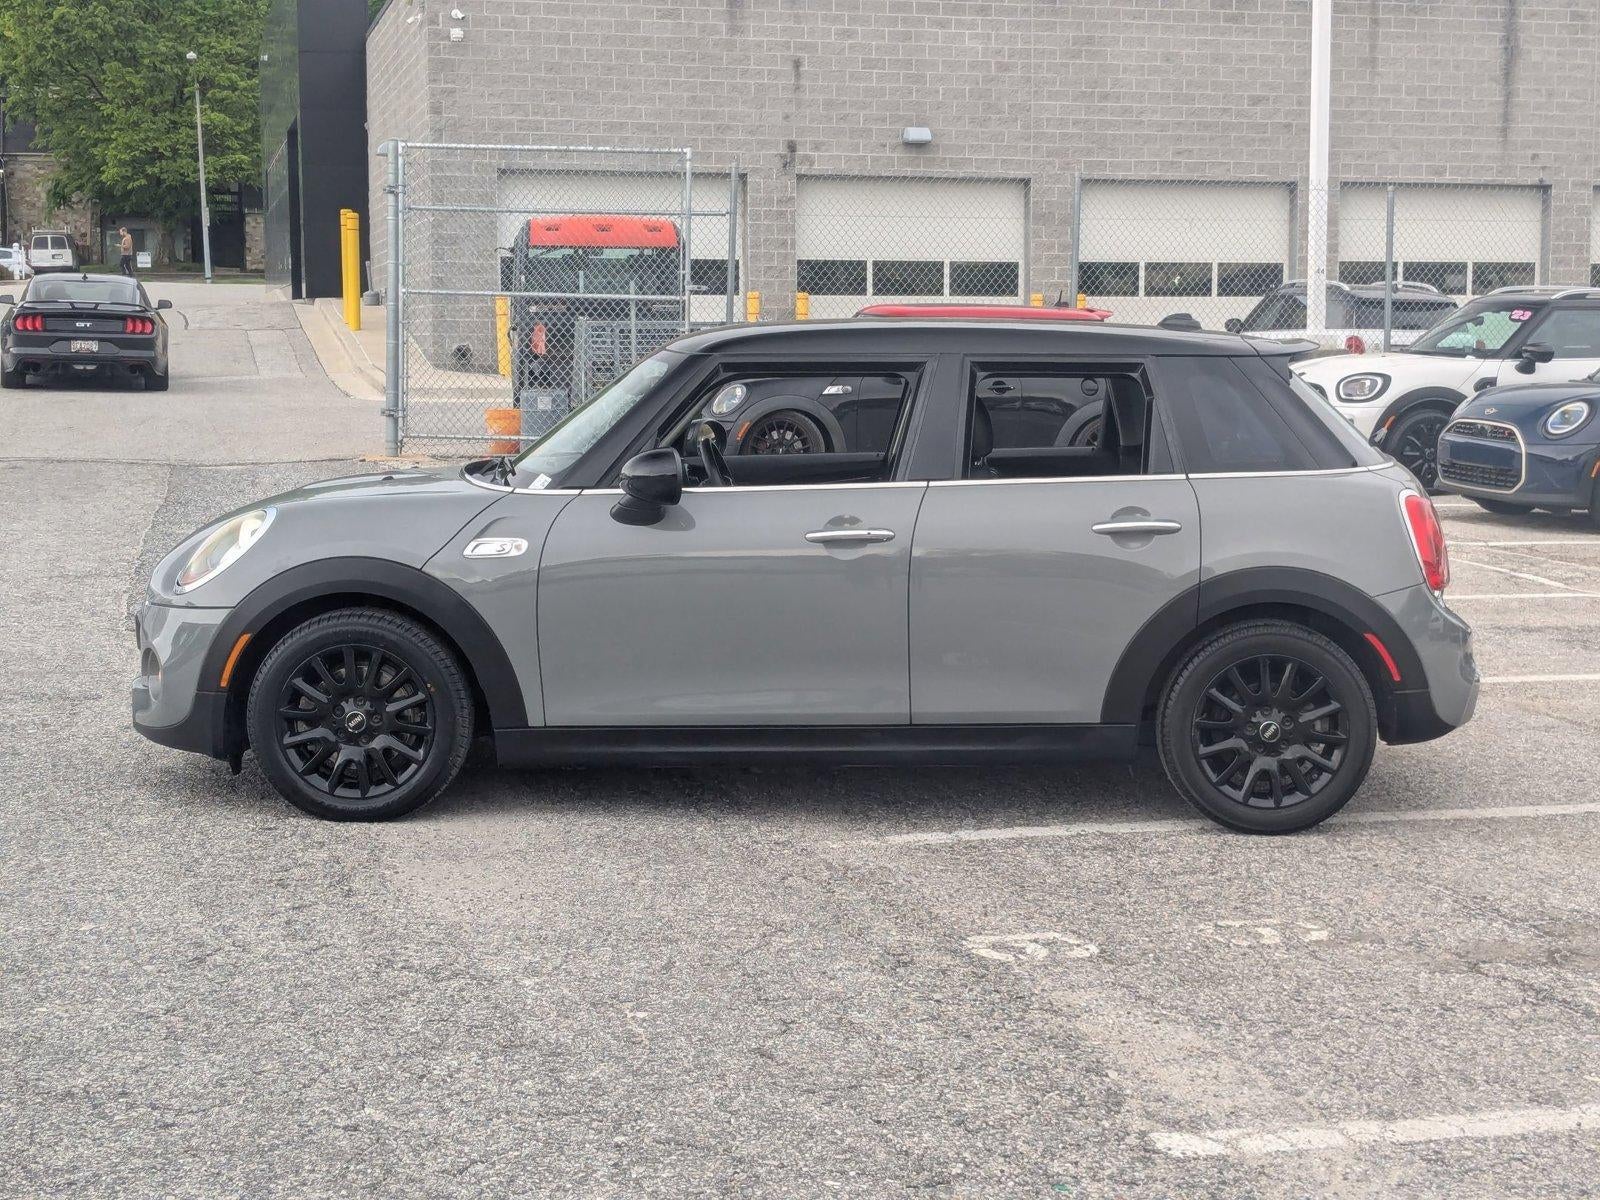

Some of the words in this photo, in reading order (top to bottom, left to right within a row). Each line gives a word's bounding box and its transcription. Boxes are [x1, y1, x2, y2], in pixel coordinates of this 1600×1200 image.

[1511, 310, 1531, 320] 23
[495, 543, 508, 553] S
[348, 715, 362, 727] MINI
